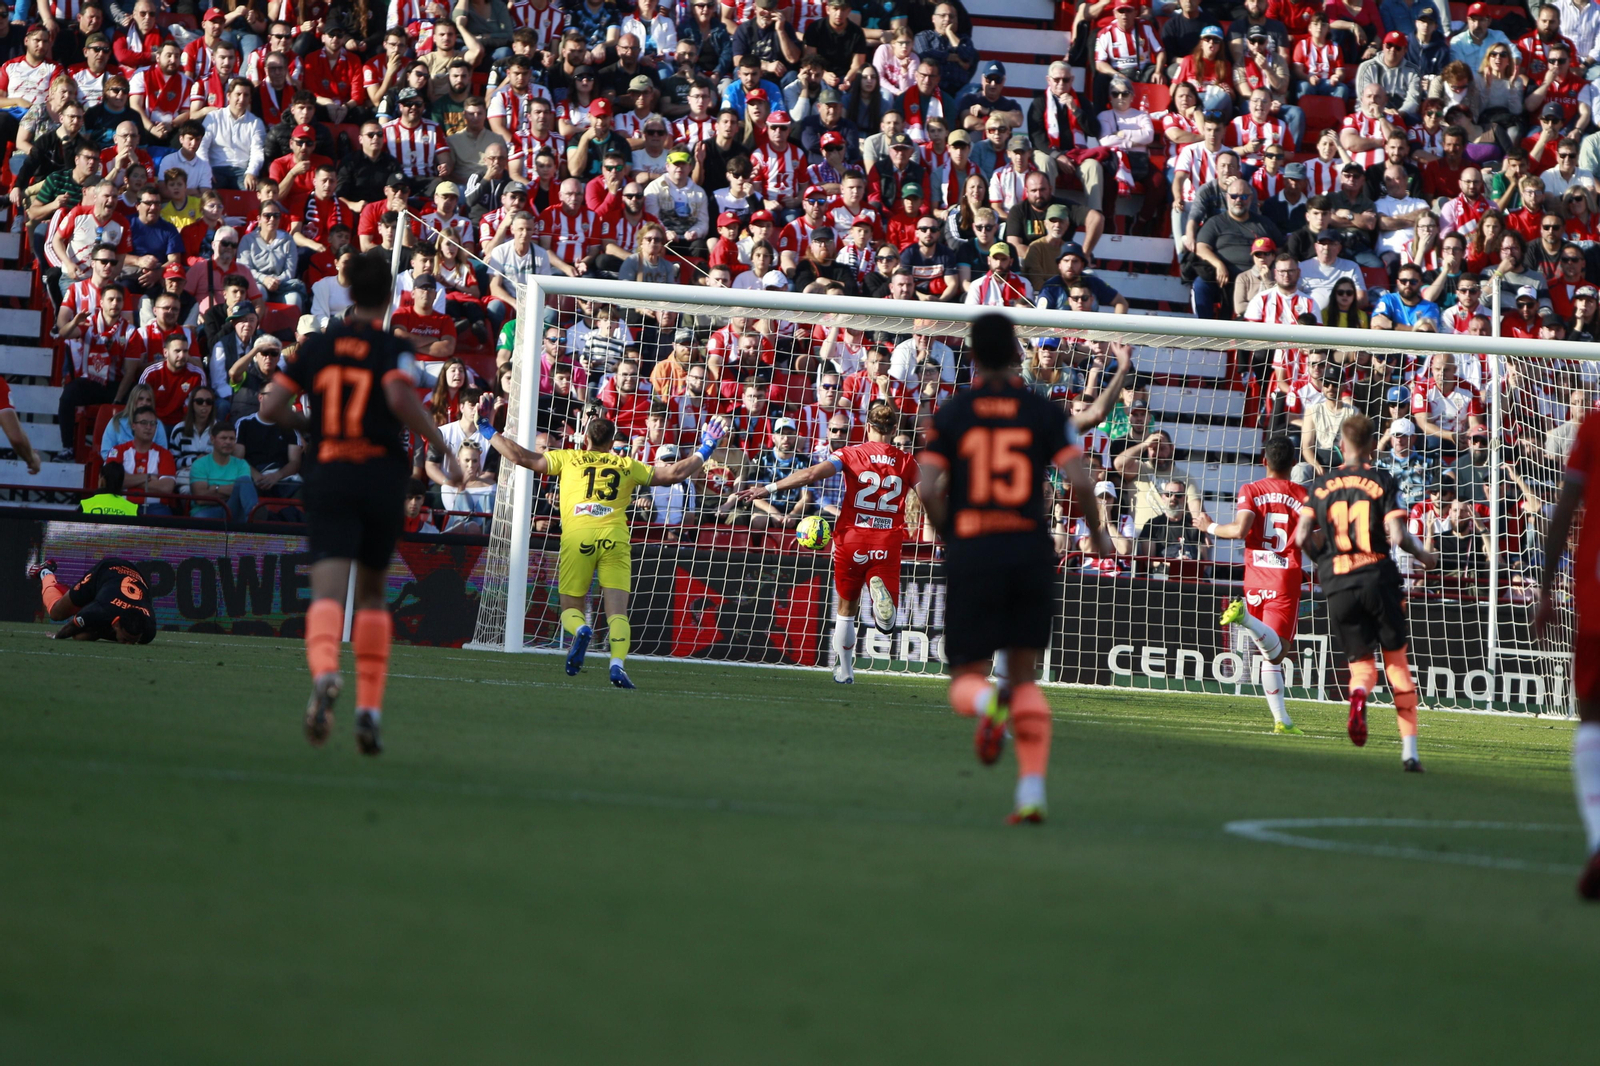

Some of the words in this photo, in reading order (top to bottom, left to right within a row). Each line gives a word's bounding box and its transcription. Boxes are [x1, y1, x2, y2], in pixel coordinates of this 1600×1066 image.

[312, 364, 373, 438] 17
[869, 454, 897, 467] BABIĆ
[957, 425, 1033, 508] 15
[582, 466, 620, 501] 13
[854, 470, 903, 513] 22
[874, 517, 892, 525] POWER
[1262, 512, 1289, 553] 5
[1327, 500, 1372, 554] 11
[868, 550, 889, 560] TCI
[138, 551, 313, 620] POWE
